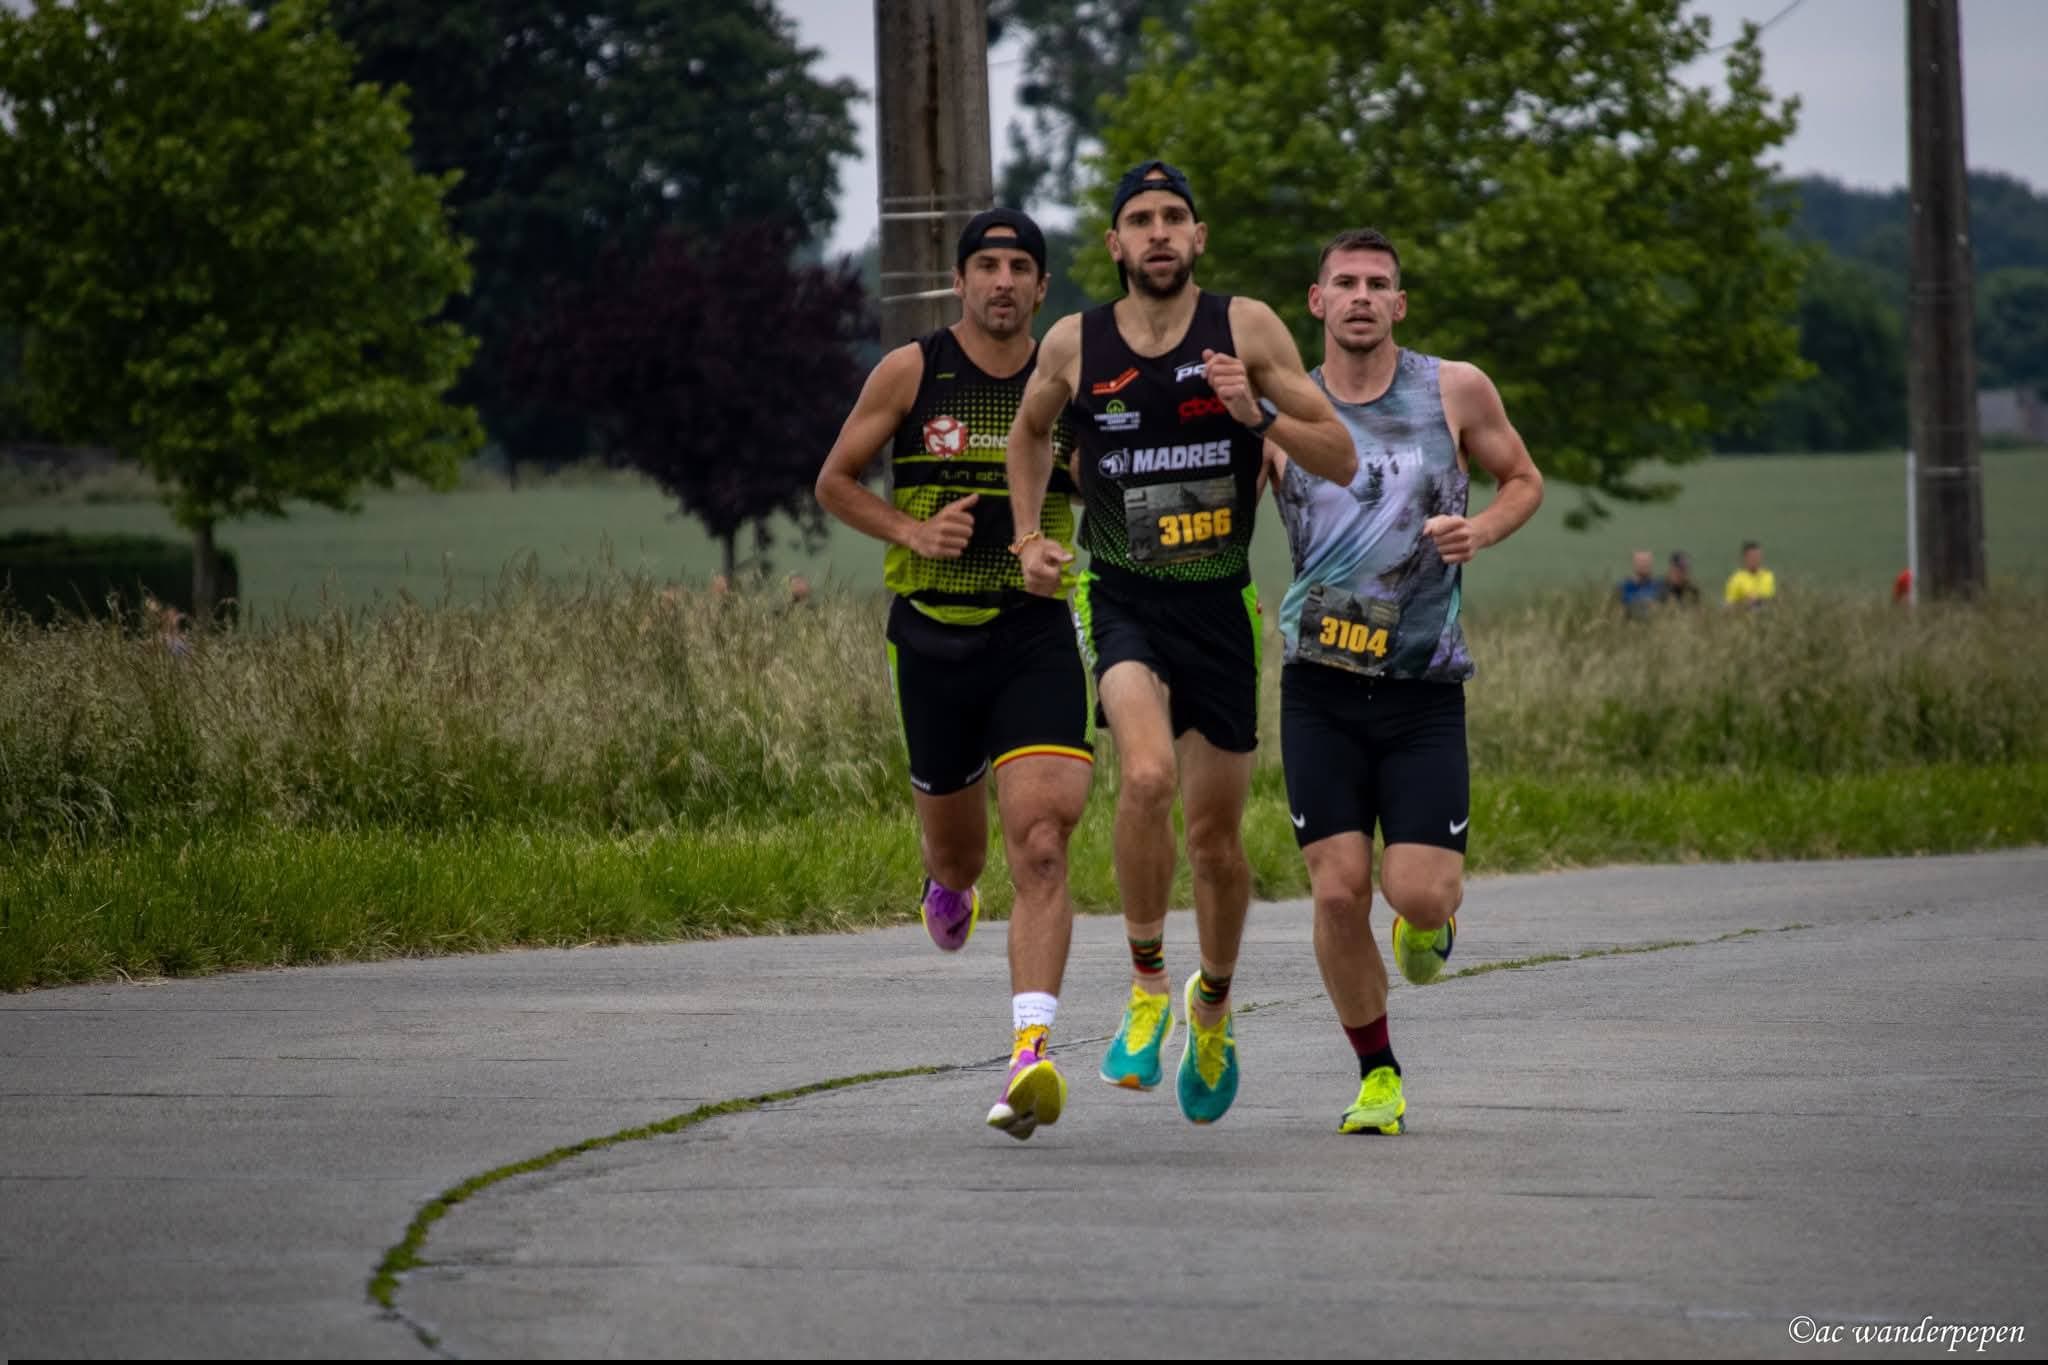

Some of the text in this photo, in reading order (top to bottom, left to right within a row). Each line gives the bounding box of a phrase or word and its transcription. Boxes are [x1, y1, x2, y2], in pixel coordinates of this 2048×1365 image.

[1132, 439, 1232, 474] MADRES
[1158, 507, 1233, 547] 3166
[1319, 615, 1389, 658] 3104
